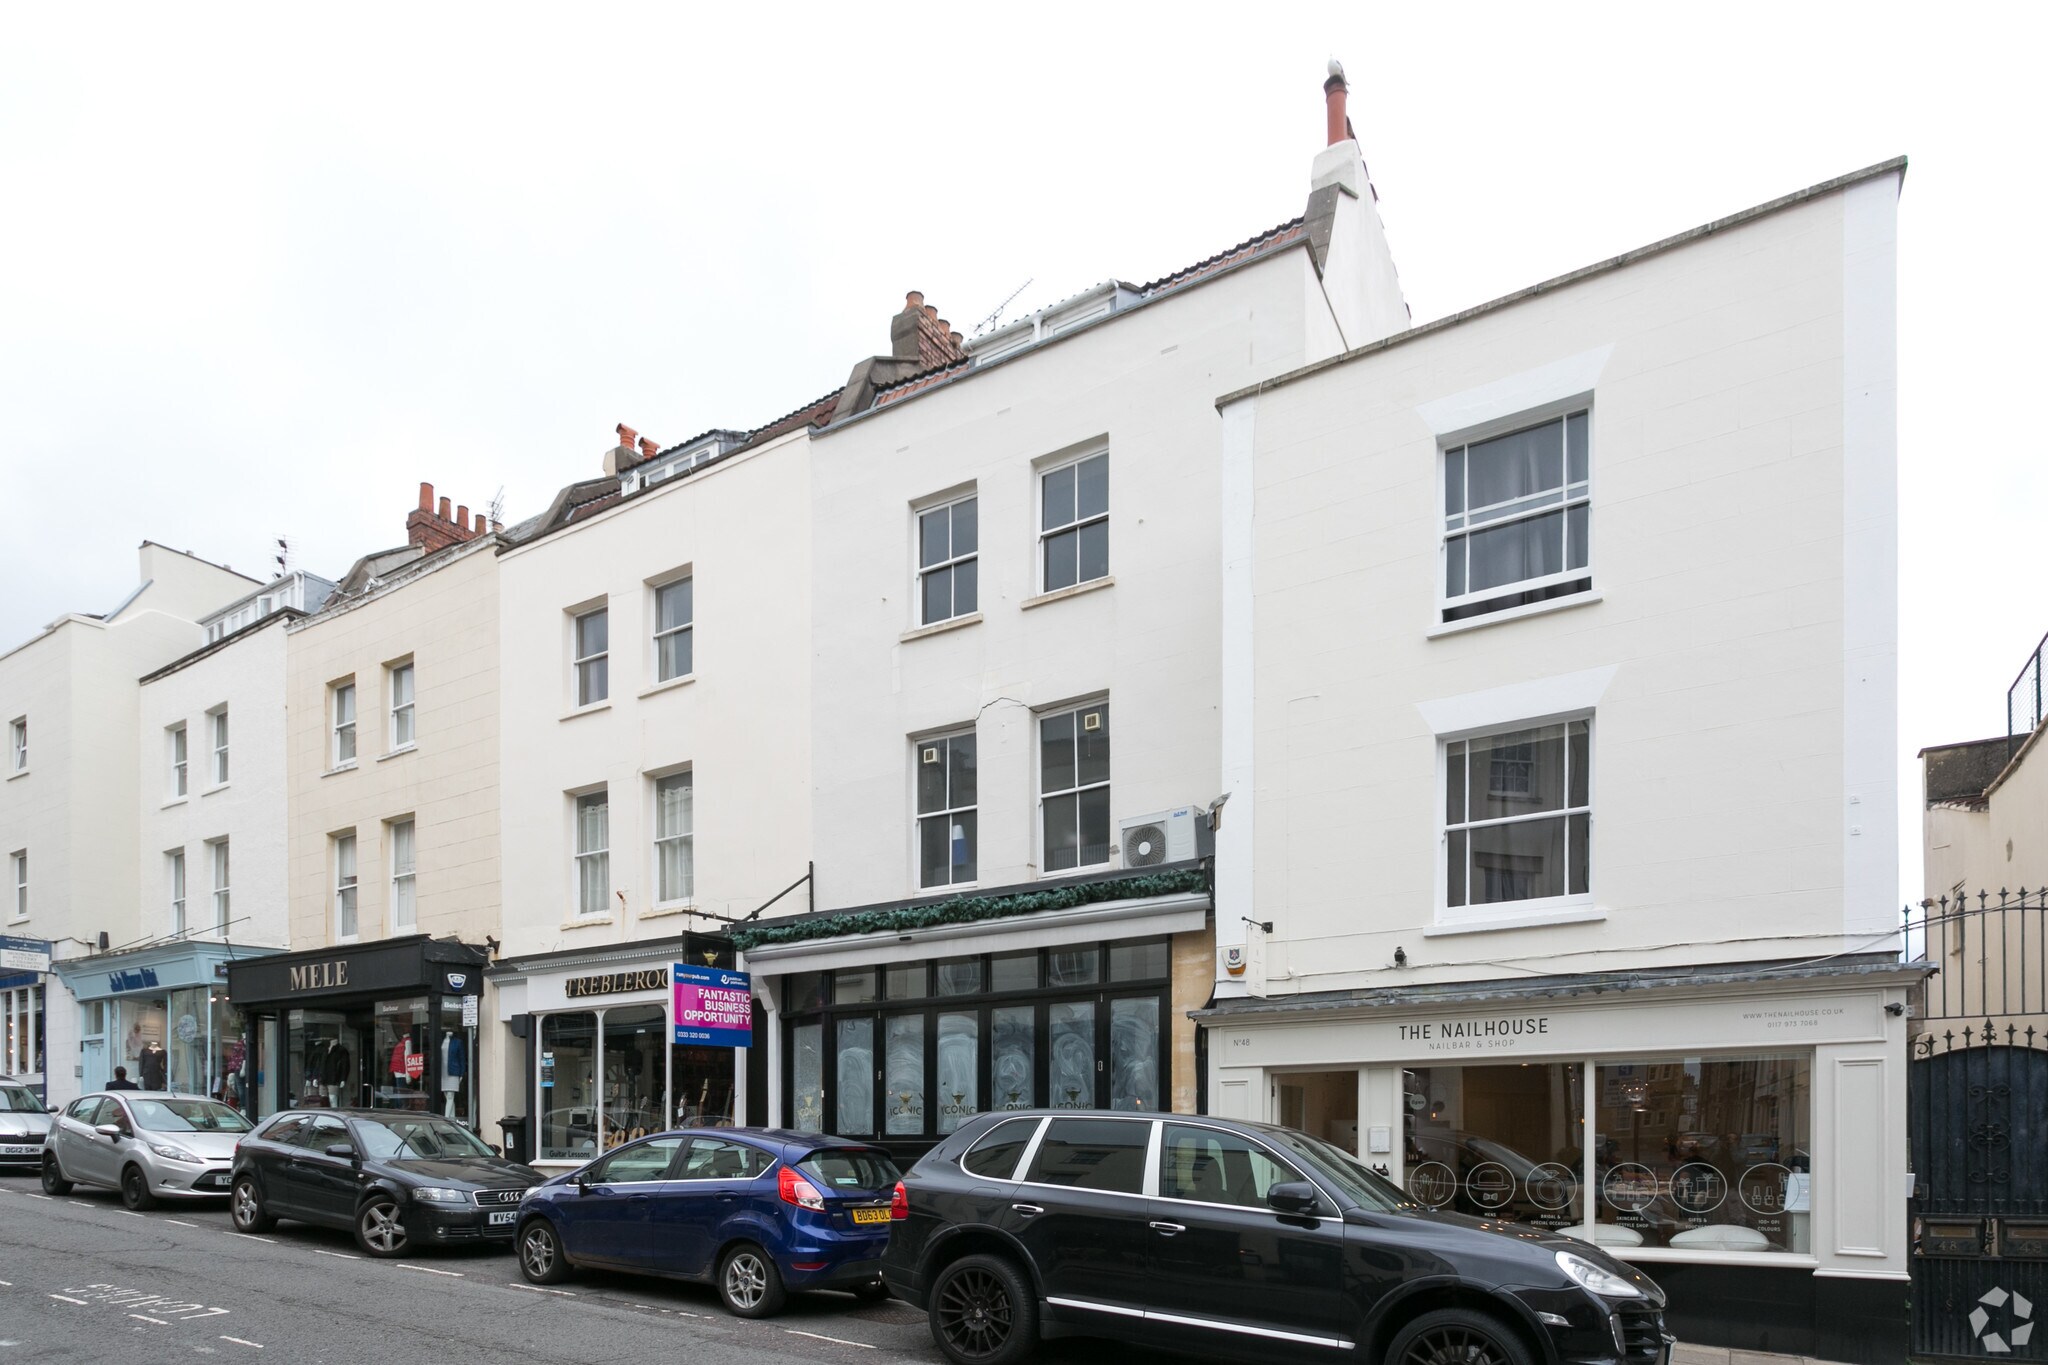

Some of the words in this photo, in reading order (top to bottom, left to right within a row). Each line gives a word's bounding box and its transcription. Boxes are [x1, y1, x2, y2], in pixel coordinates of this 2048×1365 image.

[290, 961, 349, 991] MELE
[676, 972, 710, 981] runyourpub.com
[698, 989, 750, 1003] FANTASTIC
[705, 1000, 751, 1014] BUSINESS
[684, 1010, 751, 1025] OPPORTUNITY
[1742, 1008, 1844, 1019] WWW.THENAILHOUSE.CO.UK
[1399, 1024, 1431, 1040] THE
[1441, 1018, 1548, 1039] NAILHOUSE
[1784, 1020, 1798, 1028] 973
[1429, 1042, 1471, 1050] NAILBAR
[1476, 1040, 1483, 1048] &
[1488, 1039, 1515, 1048] SHOP
[407, 1056, 423, 1066] SALE
[889, 1105, 922, 1116] ICONIC
[941, 1105, 976, 1116] ICONIC
[997, 1103, 1033, 1111] ONIC
[549, 1150, 567, 1158] Guitar
[568, 1150, 591, 1158] Lessons
[493, 1212, 516, 1223] WV54
[856, 1209, 879, 1221] BD63
[1939, 1241, 1957, 1251] 48
